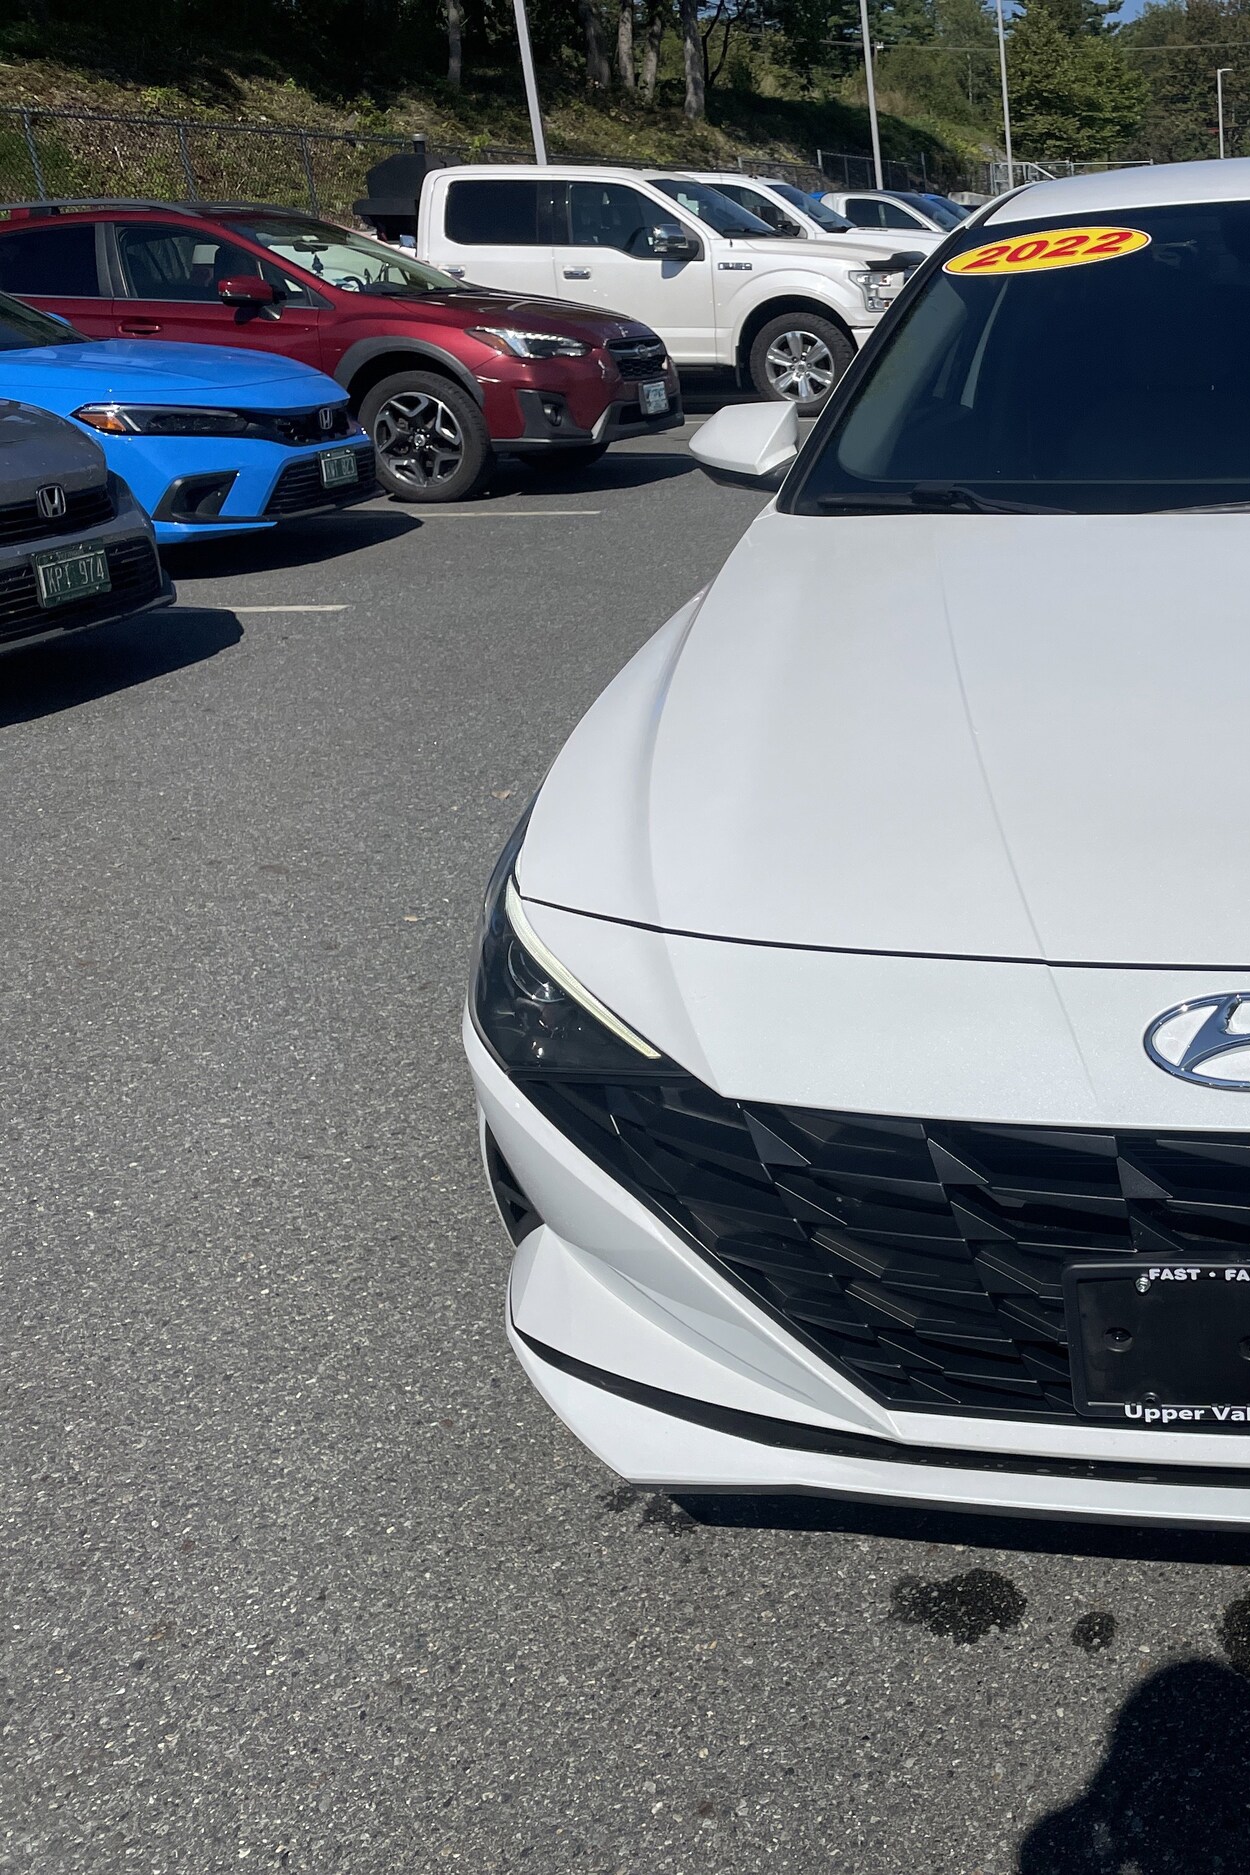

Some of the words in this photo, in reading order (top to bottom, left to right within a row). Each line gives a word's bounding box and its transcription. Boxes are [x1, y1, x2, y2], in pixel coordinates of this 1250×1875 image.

[960, 231, 1134, 271] 2022
[79, 556, 105, 585] 974
[1149, 1268, 1201, 1281] FAST
[1124, 1404, 1205, 1423] Upper
